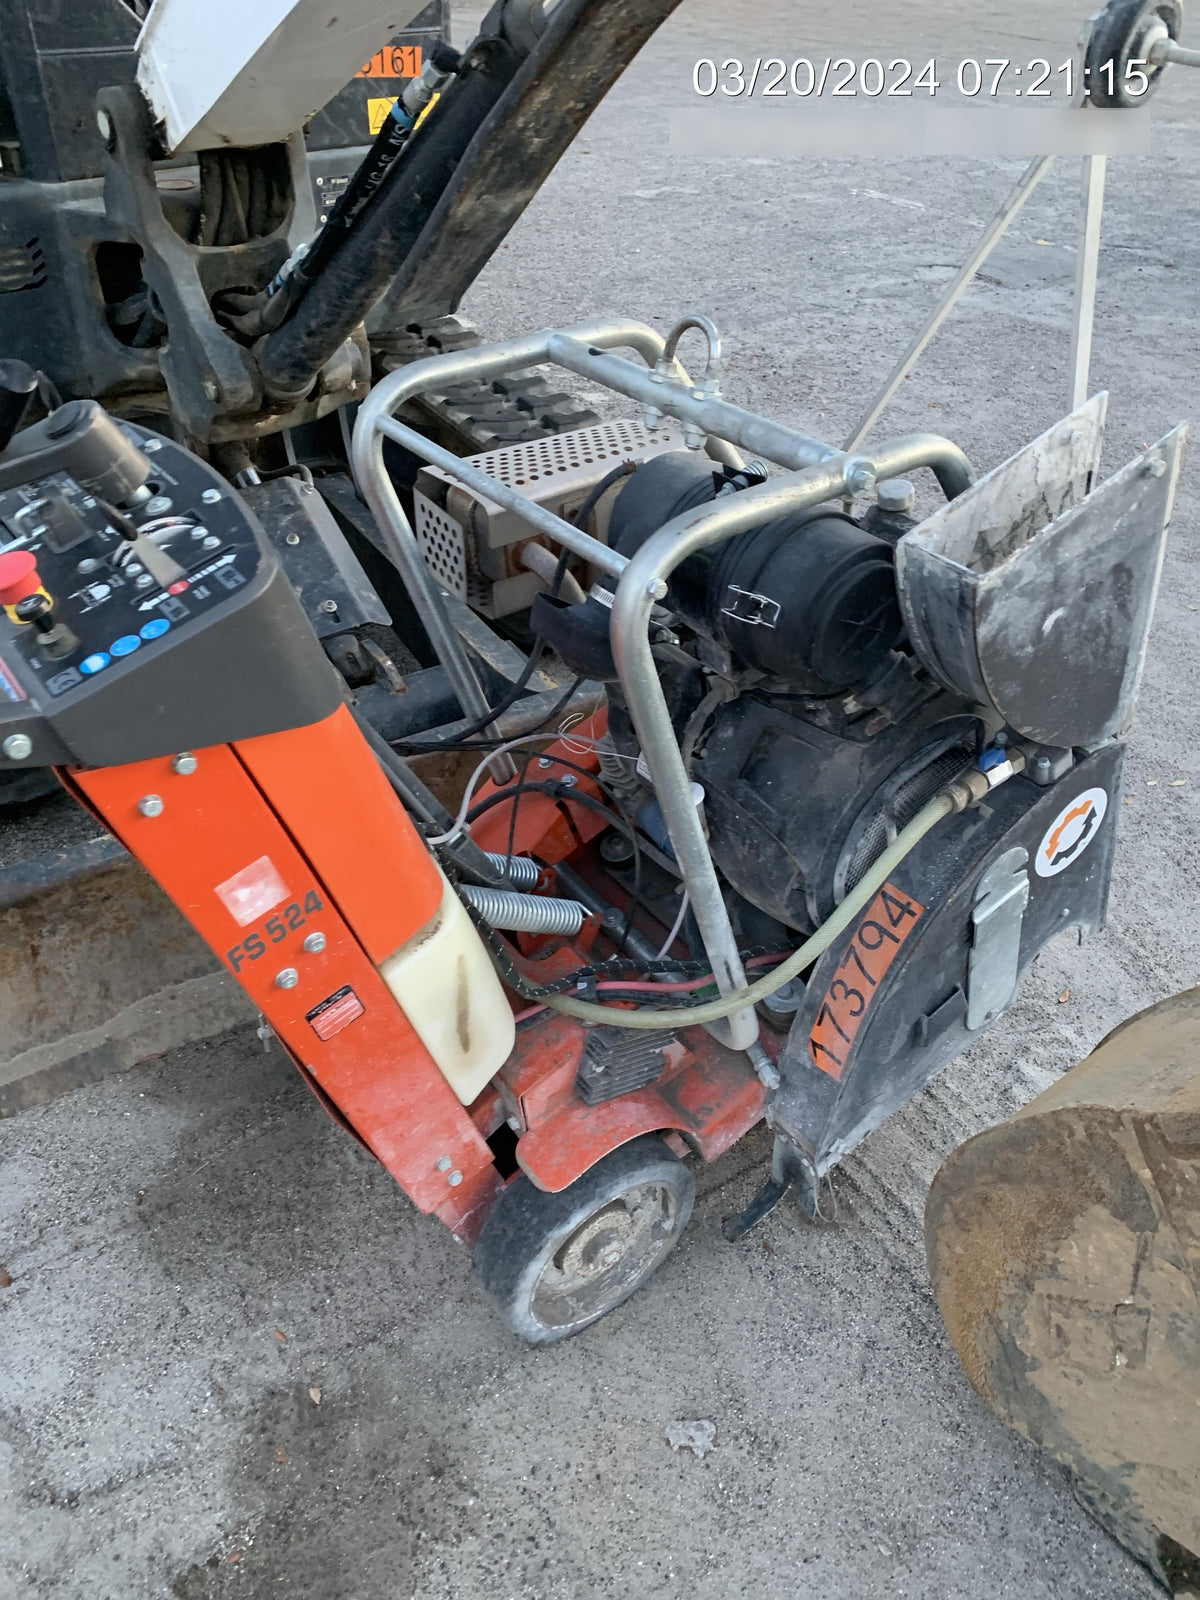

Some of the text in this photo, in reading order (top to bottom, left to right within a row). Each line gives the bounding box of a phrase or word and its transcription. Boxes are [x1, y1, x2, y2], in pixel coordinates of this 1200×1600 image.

[227, 889, 324, 973] FS 524
[810, 889, 918, 1067] 173794
